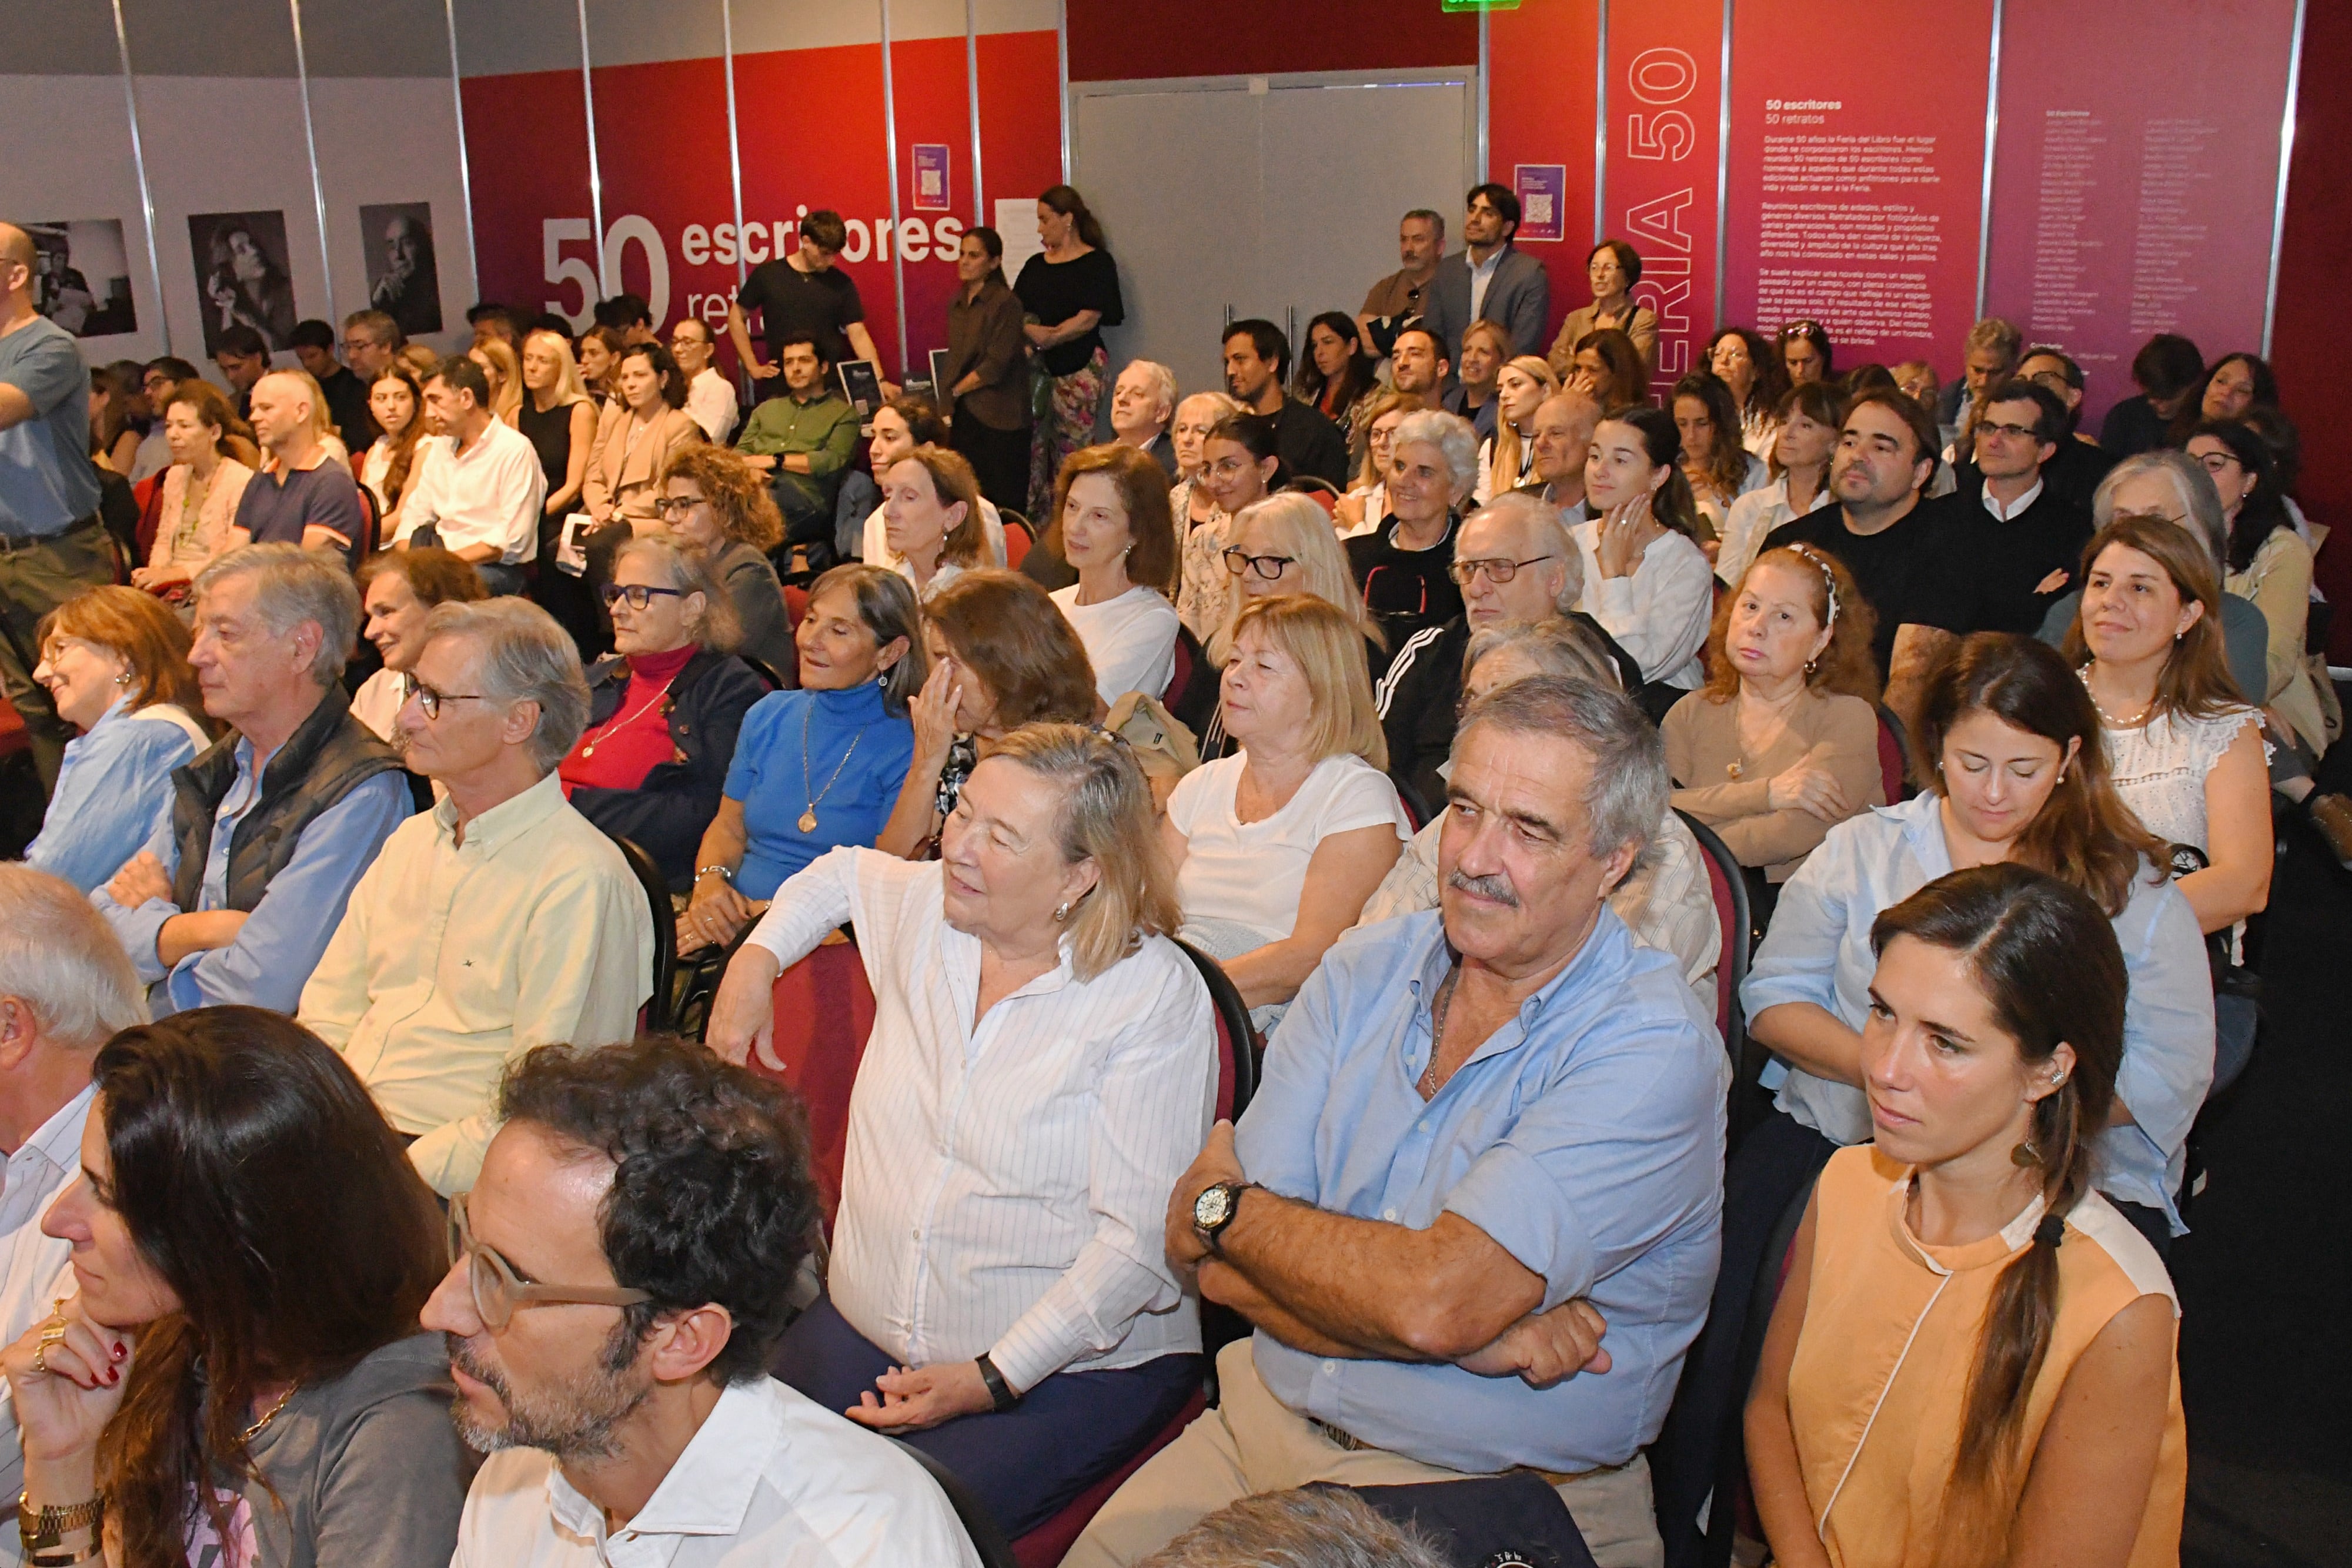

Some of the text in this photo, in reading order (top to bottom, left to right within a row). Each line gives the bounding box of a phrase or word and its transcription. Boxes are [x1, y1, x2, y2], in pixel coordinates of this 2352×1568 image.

[1628, 47, 1697, 162] 50
[1765, 113, 1825, 124] 50 retratos
[1766, 99, 1842, 110] 50 escritores
[543, 214, 670, 337] 50
[681, 205, 964, 266] escrores
